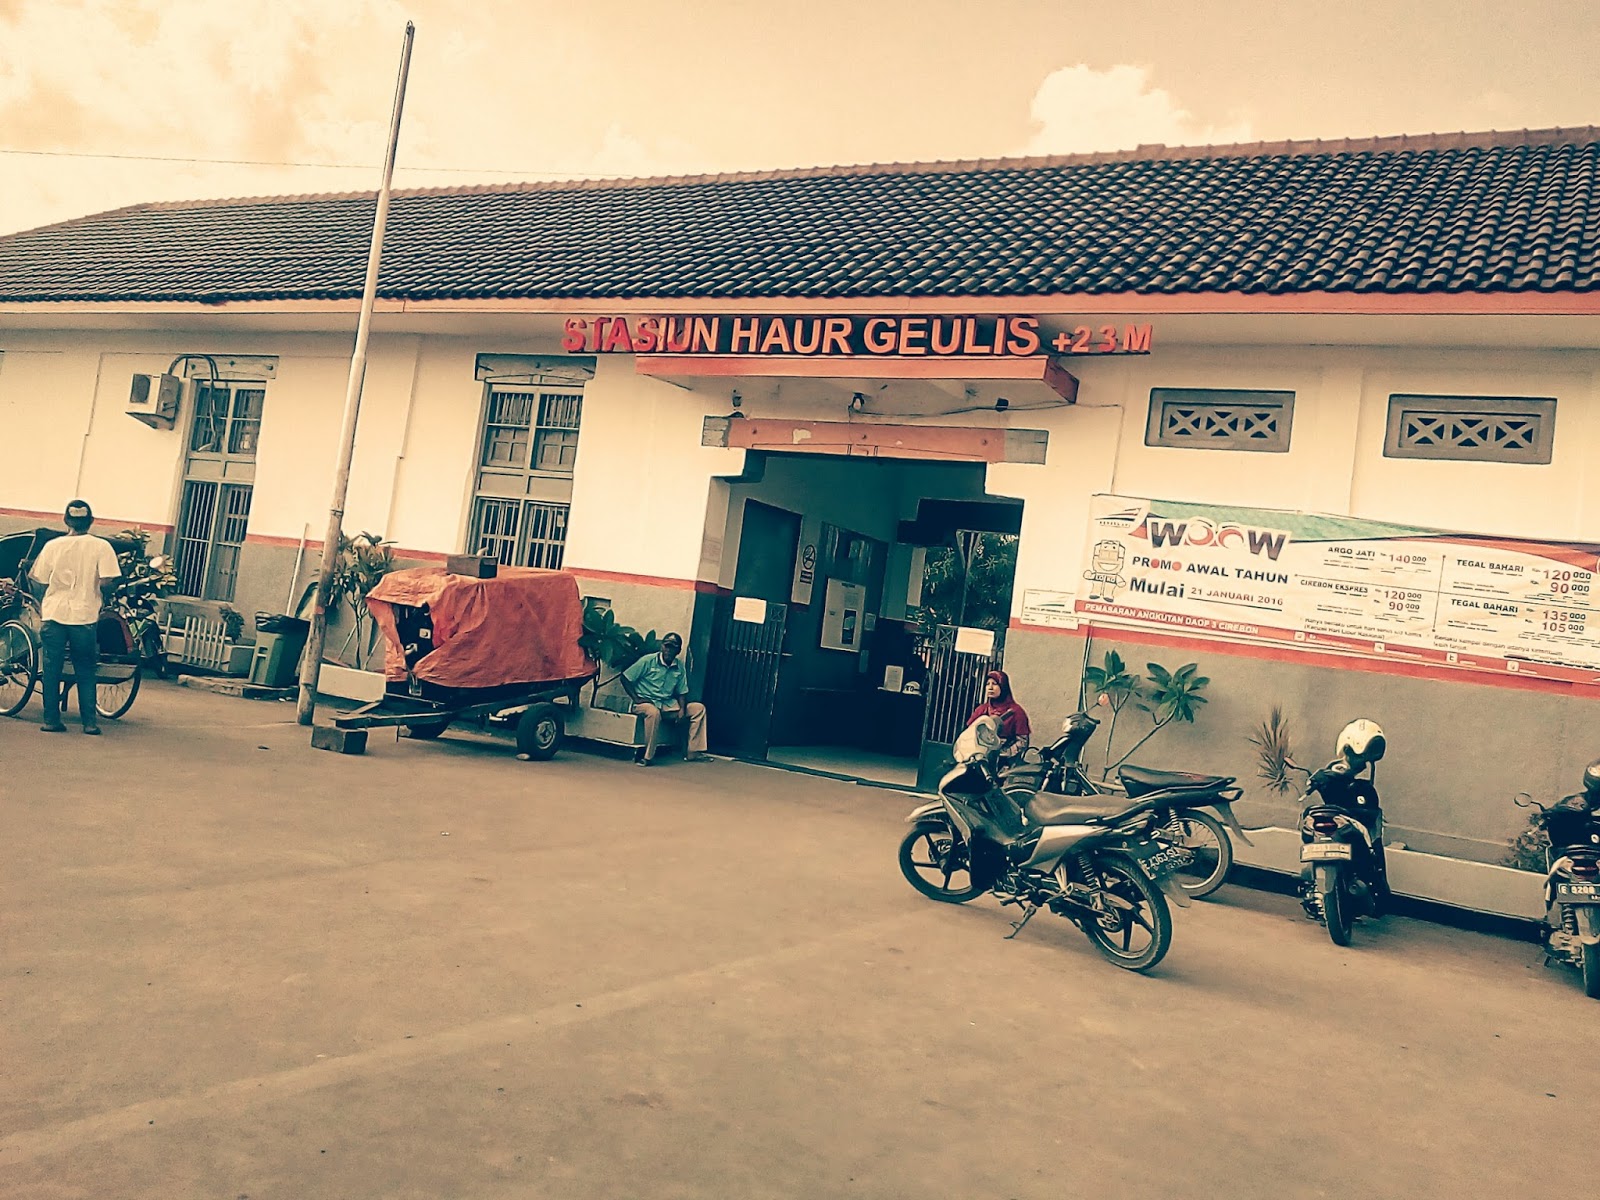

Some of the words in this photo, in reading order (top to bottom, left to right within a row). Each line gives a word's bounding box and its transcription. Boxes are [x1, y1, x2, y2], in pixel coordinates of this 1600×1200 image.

[561, 317, 719, 352] STASIUN
[730, 317, 853, 354] HAUR
[863, 317, 1040, 356] GEULIS
[1328, 546, 1353, 555] ARGO
[1389, 553, 1410, 564] 140
[1132, 556, 1182, 572] PROMO
[1186, 563, 1229, 577] AWAL
[1235, 568, 1289, 584] TAHUN
[1457, 559, 1486, 569] TEGAL
[1489, 562, 1524, 573] BAHARI
[1543, 569, 1571, 581] 120
[1129, 576, 1185, 598] Mulai
[1191, 587, 1202, 595] 21
[1206, 588, 1254, 602] JANUARI
[1257, 595, 1283, 606] 2016
[1300, 579, 1333, 588] CIREBON
[1335, 584, 1369, 592] EKSPRES
[1550, 582, 1569, 594] 90
[1384, 590, 1406, 600] 120
[1388, 601, 1403, 611] 90
[1451, 599, 1480, 608] TEGAL
[1483, 602, 1519, 613] BAHARI
[1084, 603, 1136, 617] PEMASARAN
[1137, 610, 1184, 624] ANGKUTAN
[1218, 621, 1259, 634] CIREBON
[1542, 610, 1568, 621] 135
[1542, 622, 1566, 633] 105
